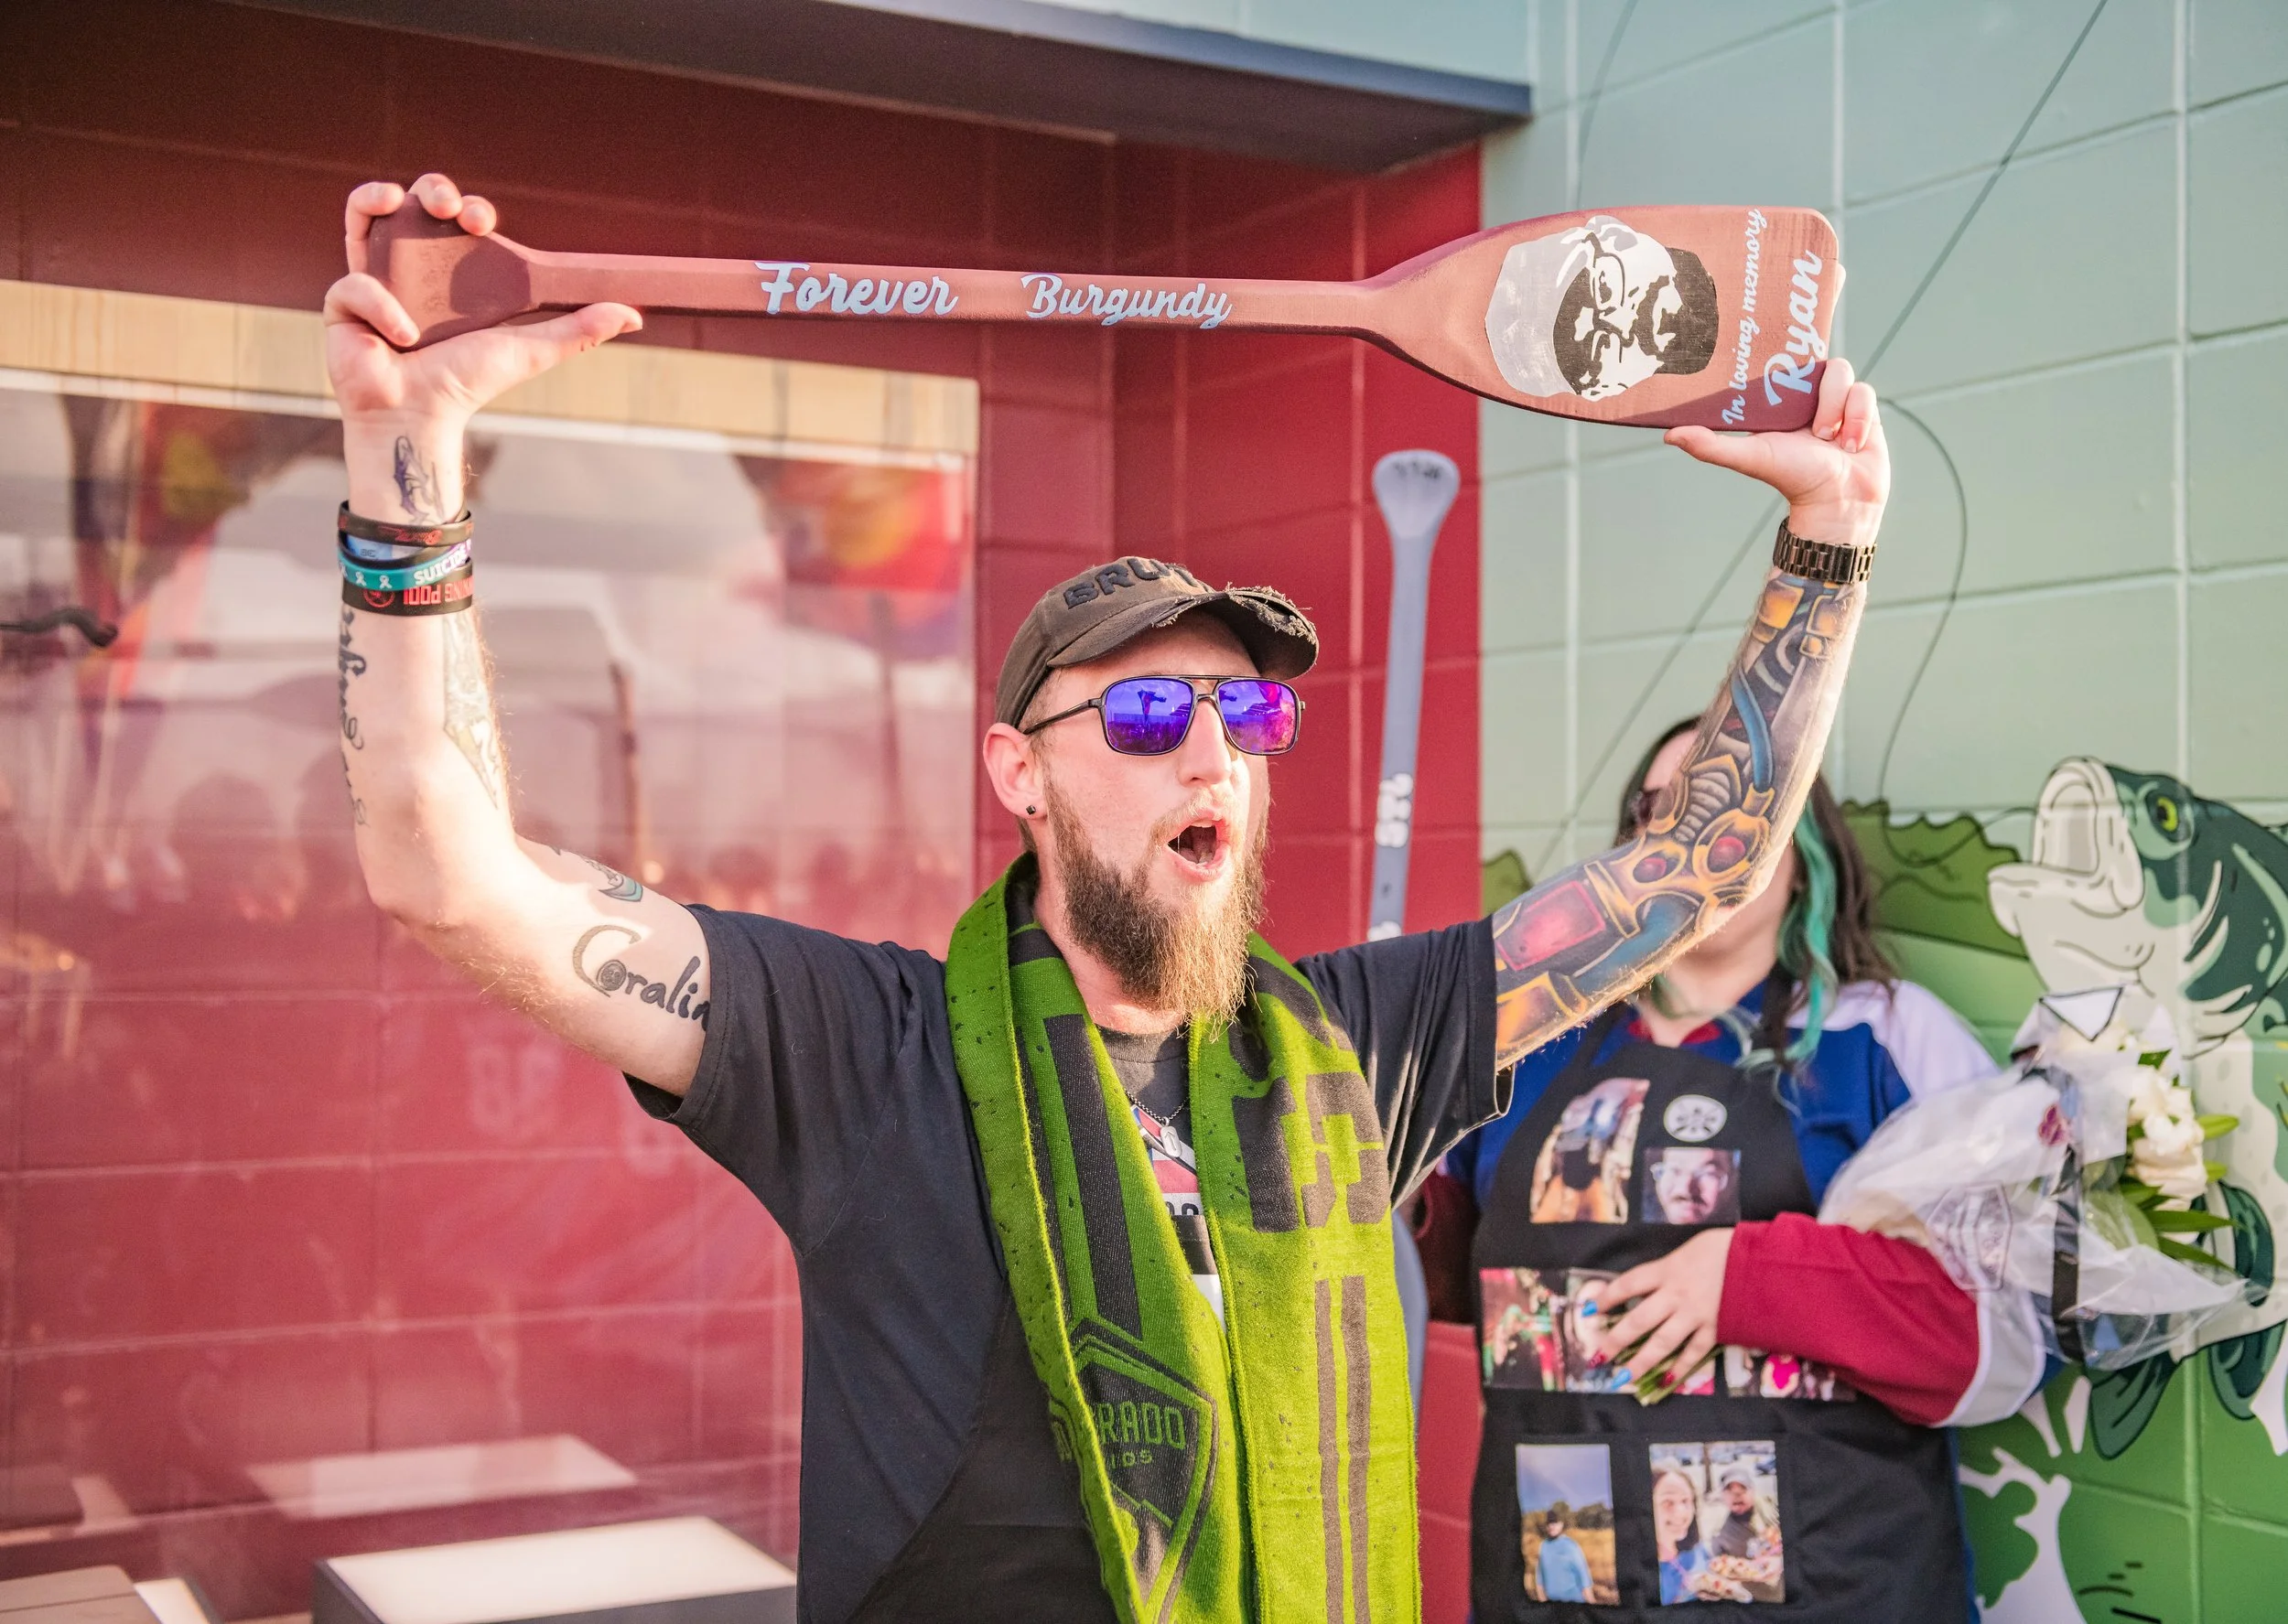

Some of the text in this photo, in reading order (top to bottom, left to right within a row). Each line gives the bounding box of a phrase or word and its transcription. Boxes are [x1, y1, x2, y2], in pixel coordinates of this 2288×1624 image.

[754, 261, 1233, 329] Forever Burgundy
[1721, 209, 1767, 425] In loving memory
[1764, 249, 1827, 406] Ryan
